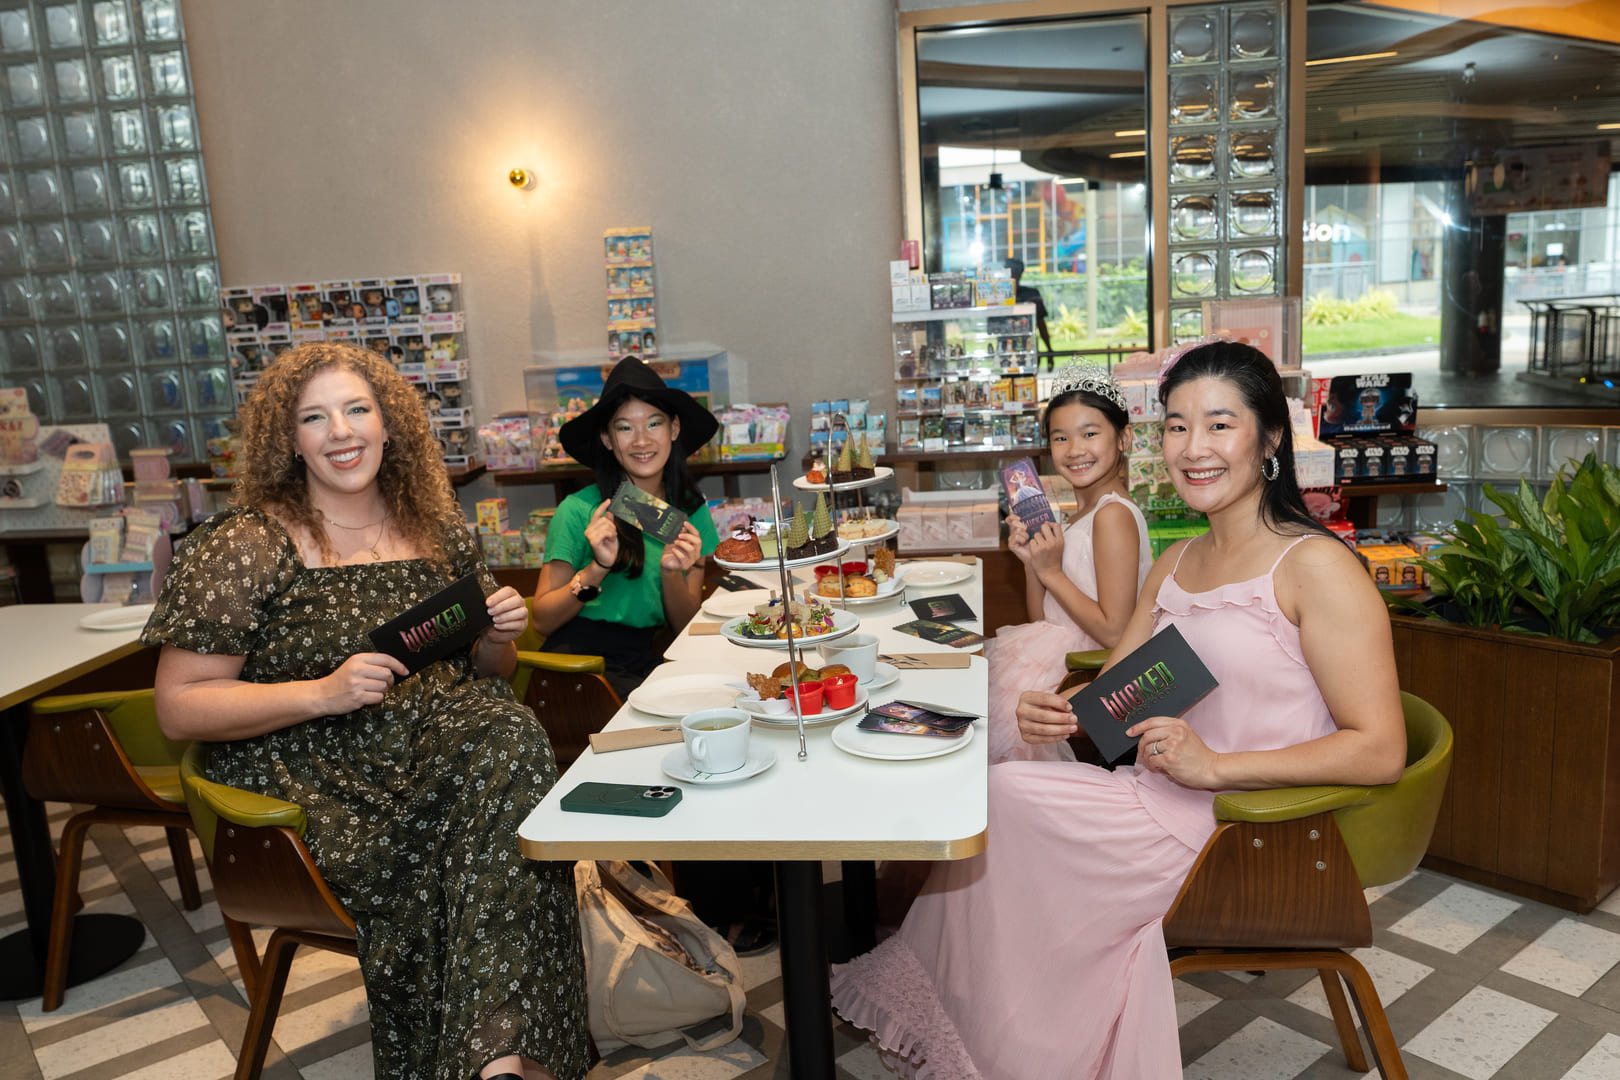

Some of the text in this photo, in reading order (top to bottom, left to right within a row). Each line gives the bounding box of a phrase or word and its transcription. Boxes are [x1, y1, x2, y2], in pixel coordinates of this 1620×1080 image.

[1356, 379, 1389, 388] WARS
[399, 602, 466, 653] WICKED
[1099, 661, 1175, 723] WICKED
